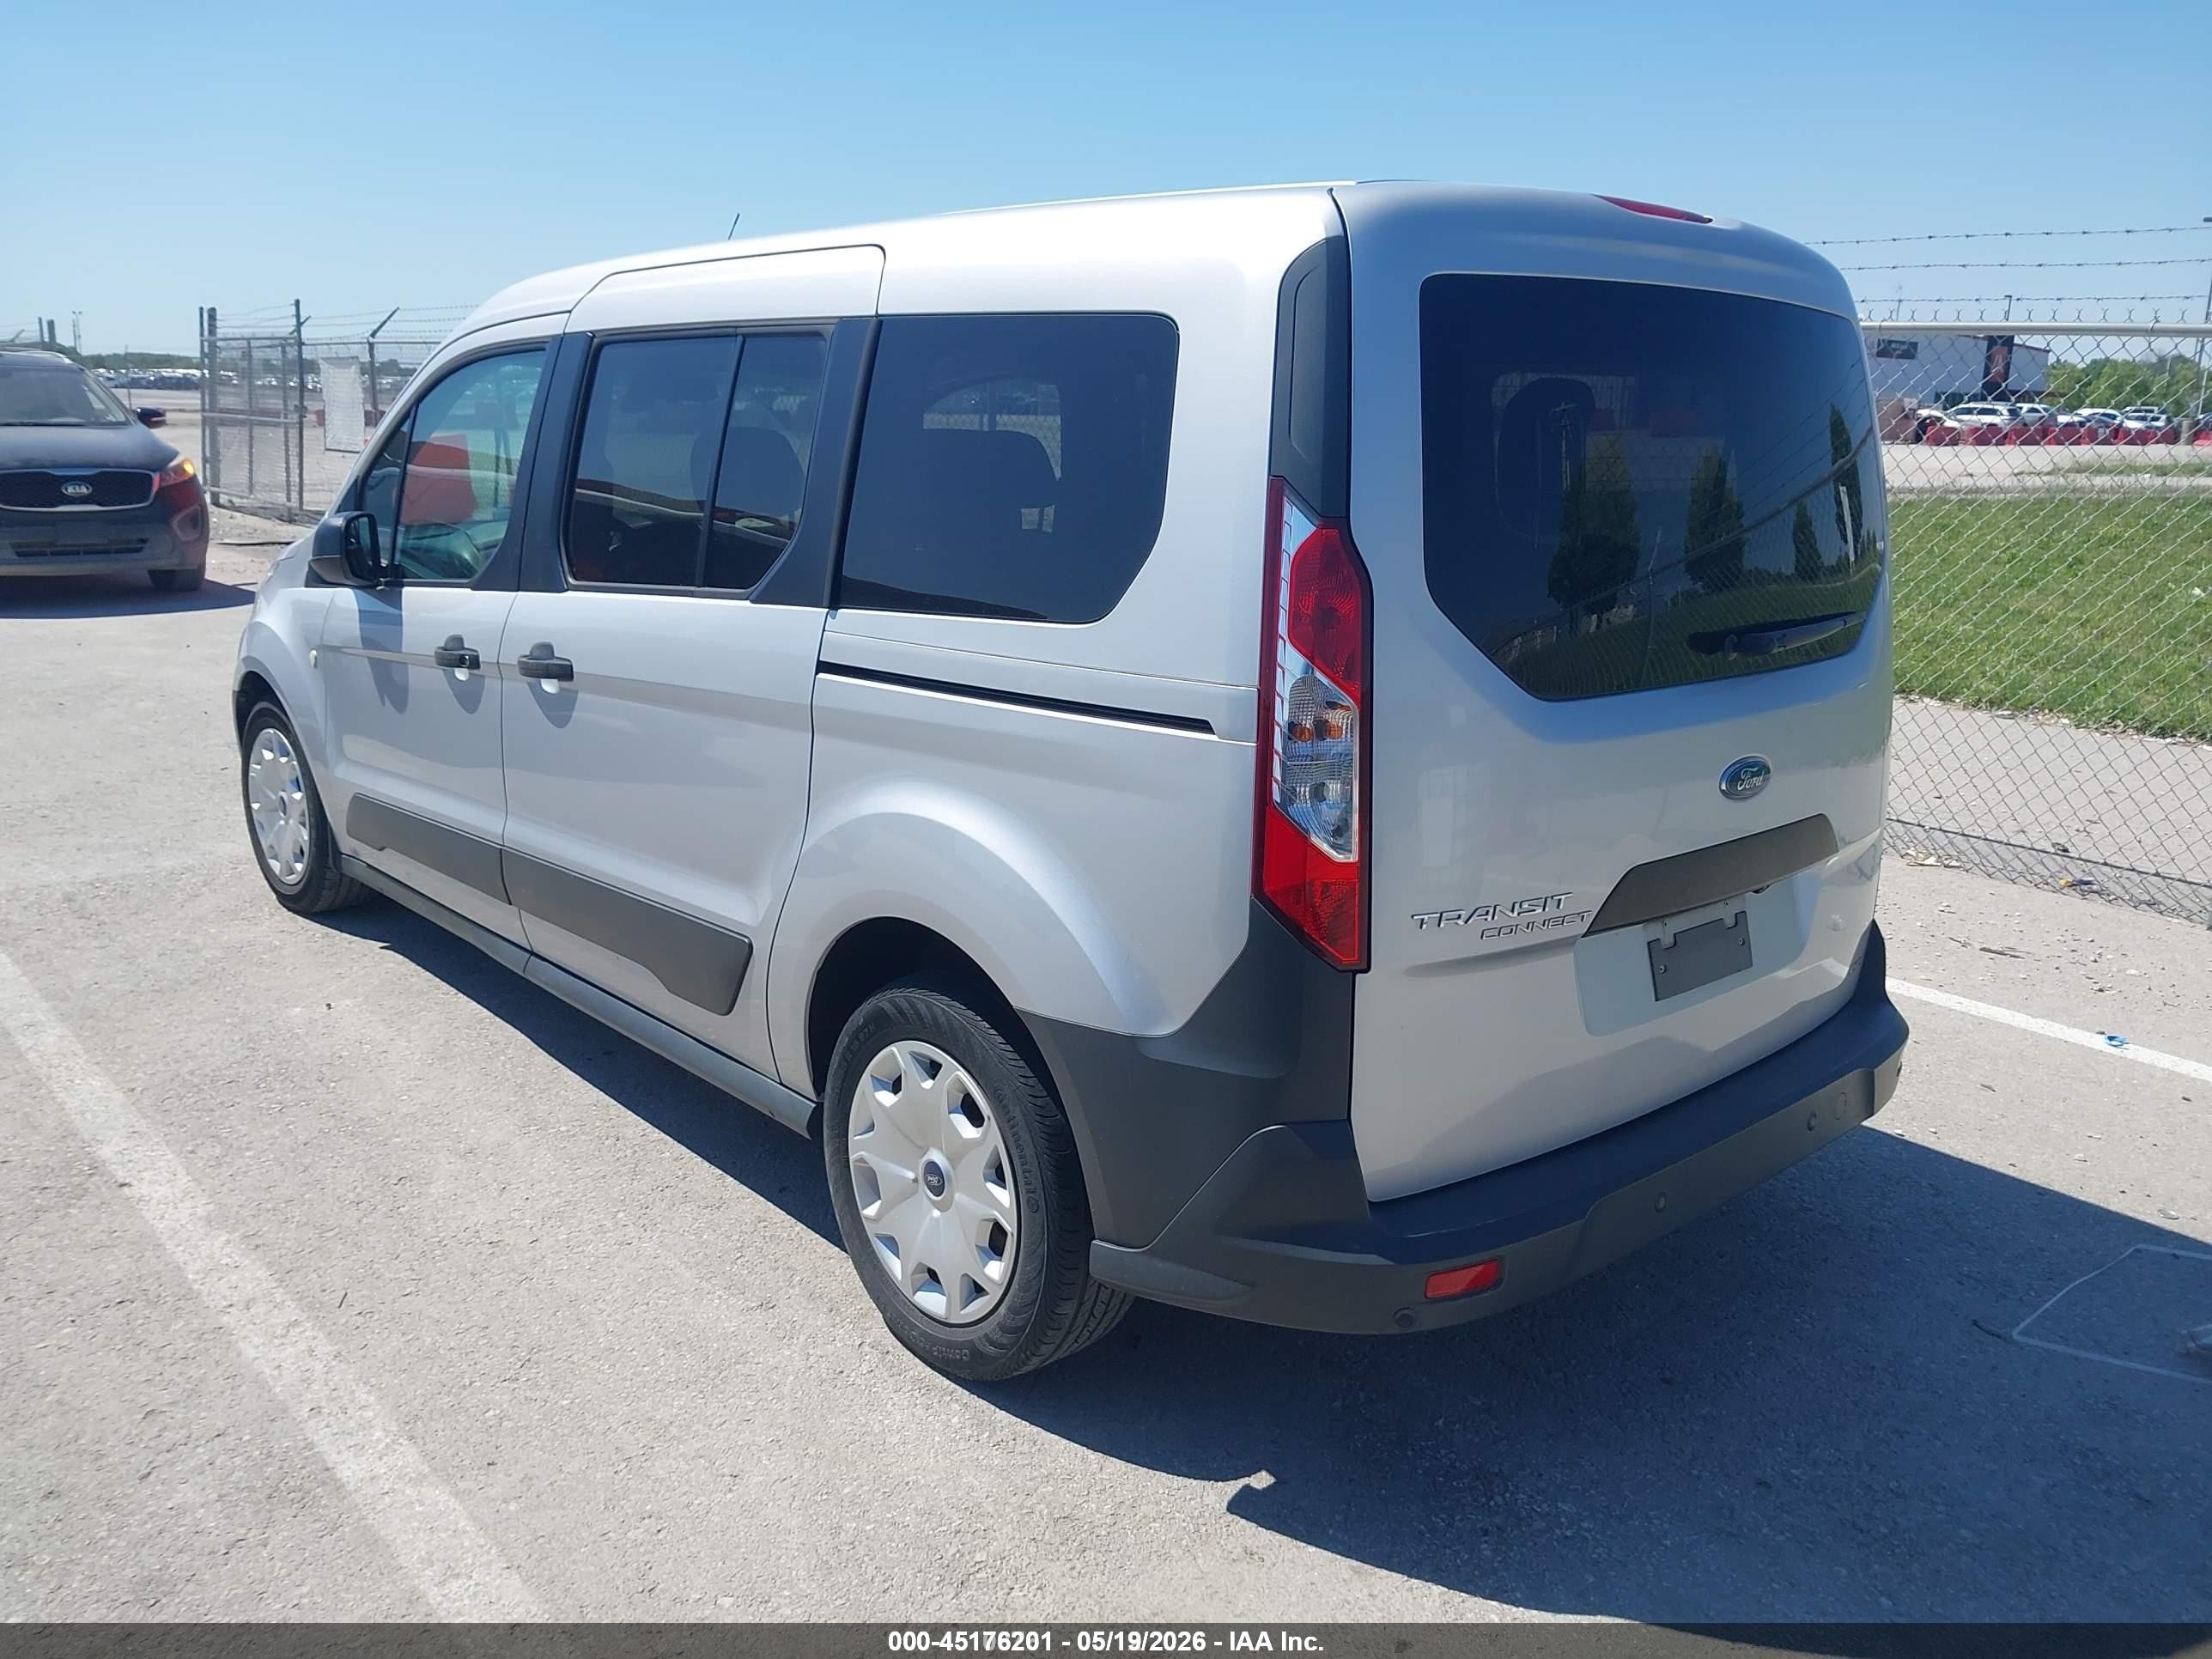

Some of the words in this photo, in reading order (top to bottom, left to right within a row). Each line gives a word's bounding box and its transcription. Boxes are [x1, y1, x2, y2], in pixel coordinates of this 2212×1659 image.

[1737, 767, 1765, 791] Ford
[1411, 891, 1573, 930] TRANSIT
[1480, 909, 1593, 940] CONNECT
